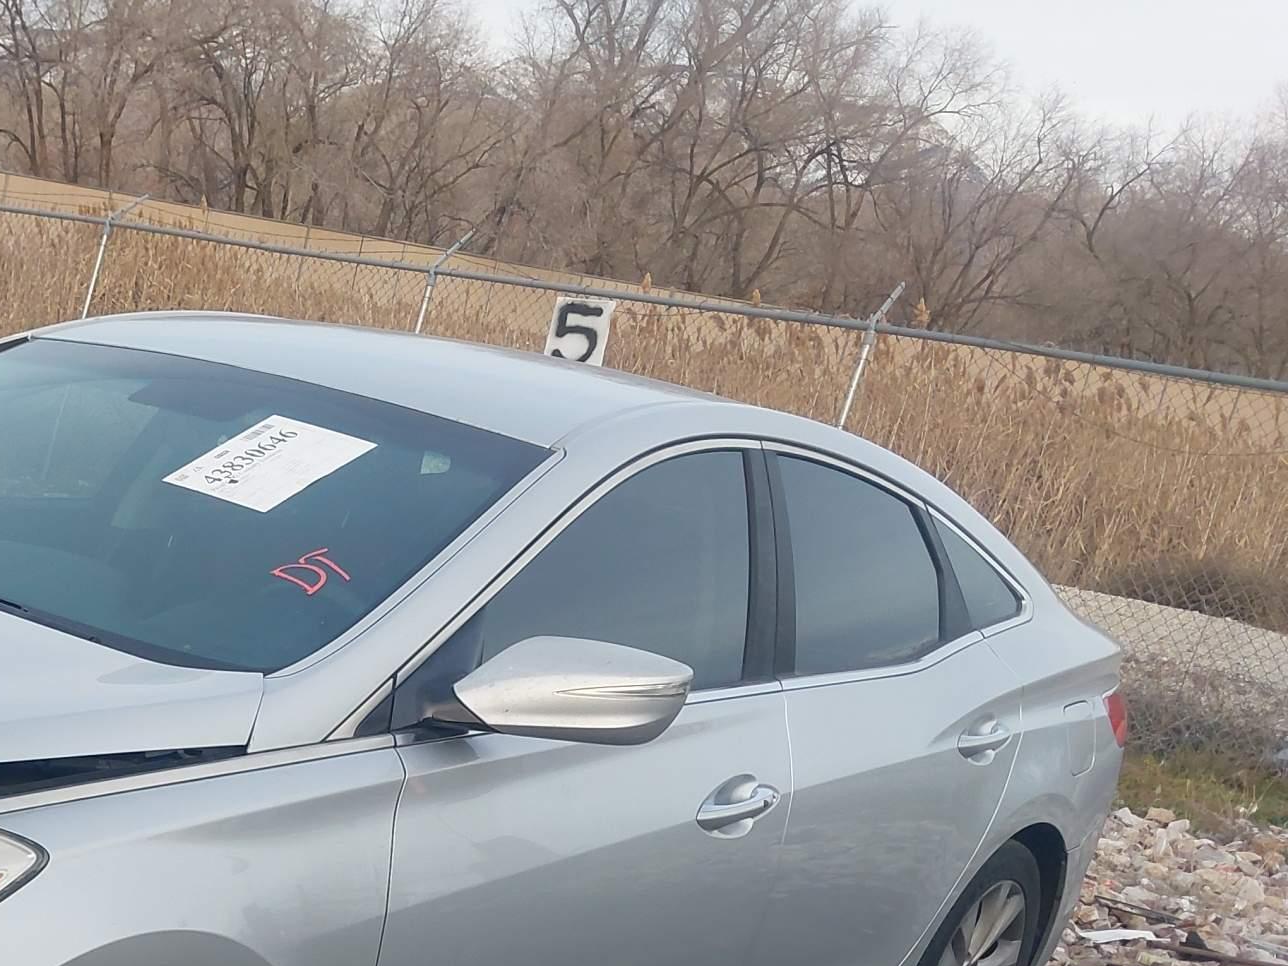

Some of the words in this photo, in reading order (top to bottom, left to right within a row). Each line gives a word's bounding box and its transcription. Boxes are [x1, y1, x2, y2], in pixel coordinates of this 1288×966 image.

[551, 302, 604, 363] 5
[203, 428, 299, 486] 43830646
[269, 547, 351, 596] DT
